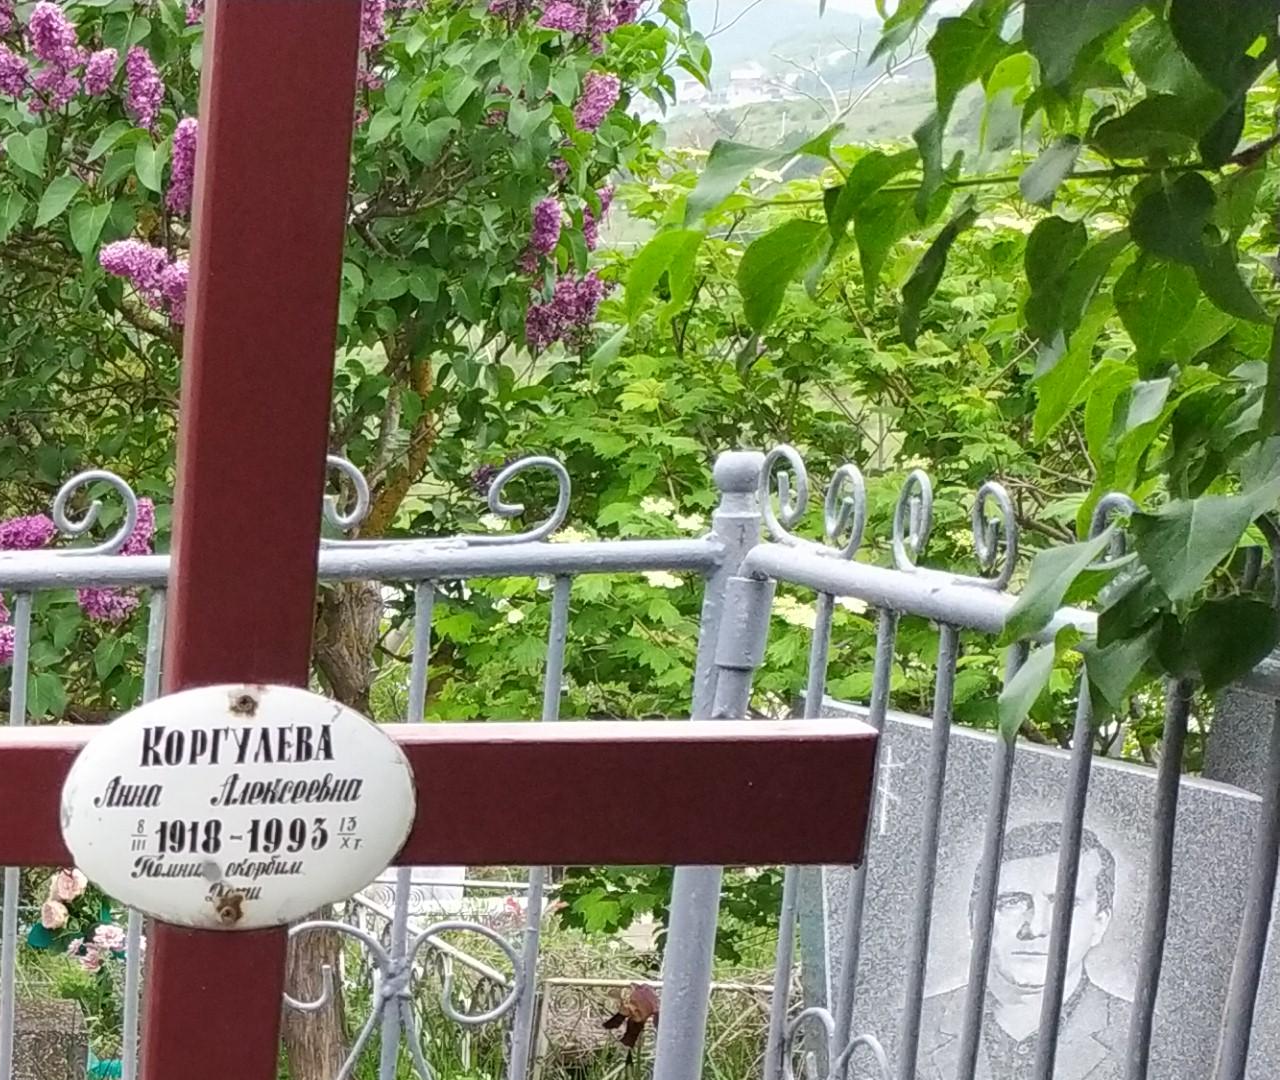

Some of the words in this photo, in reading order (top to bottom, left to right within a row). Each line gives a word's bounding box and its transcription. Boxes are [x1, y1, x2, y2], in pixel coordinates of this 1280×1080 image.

[140, 724, 335, 766] КОРГУЛЕВА
[94, 776, 163, 808] Анна
[210, 773, 363, 806] Алексеевна
[131, 853, 220, 878] Помни
